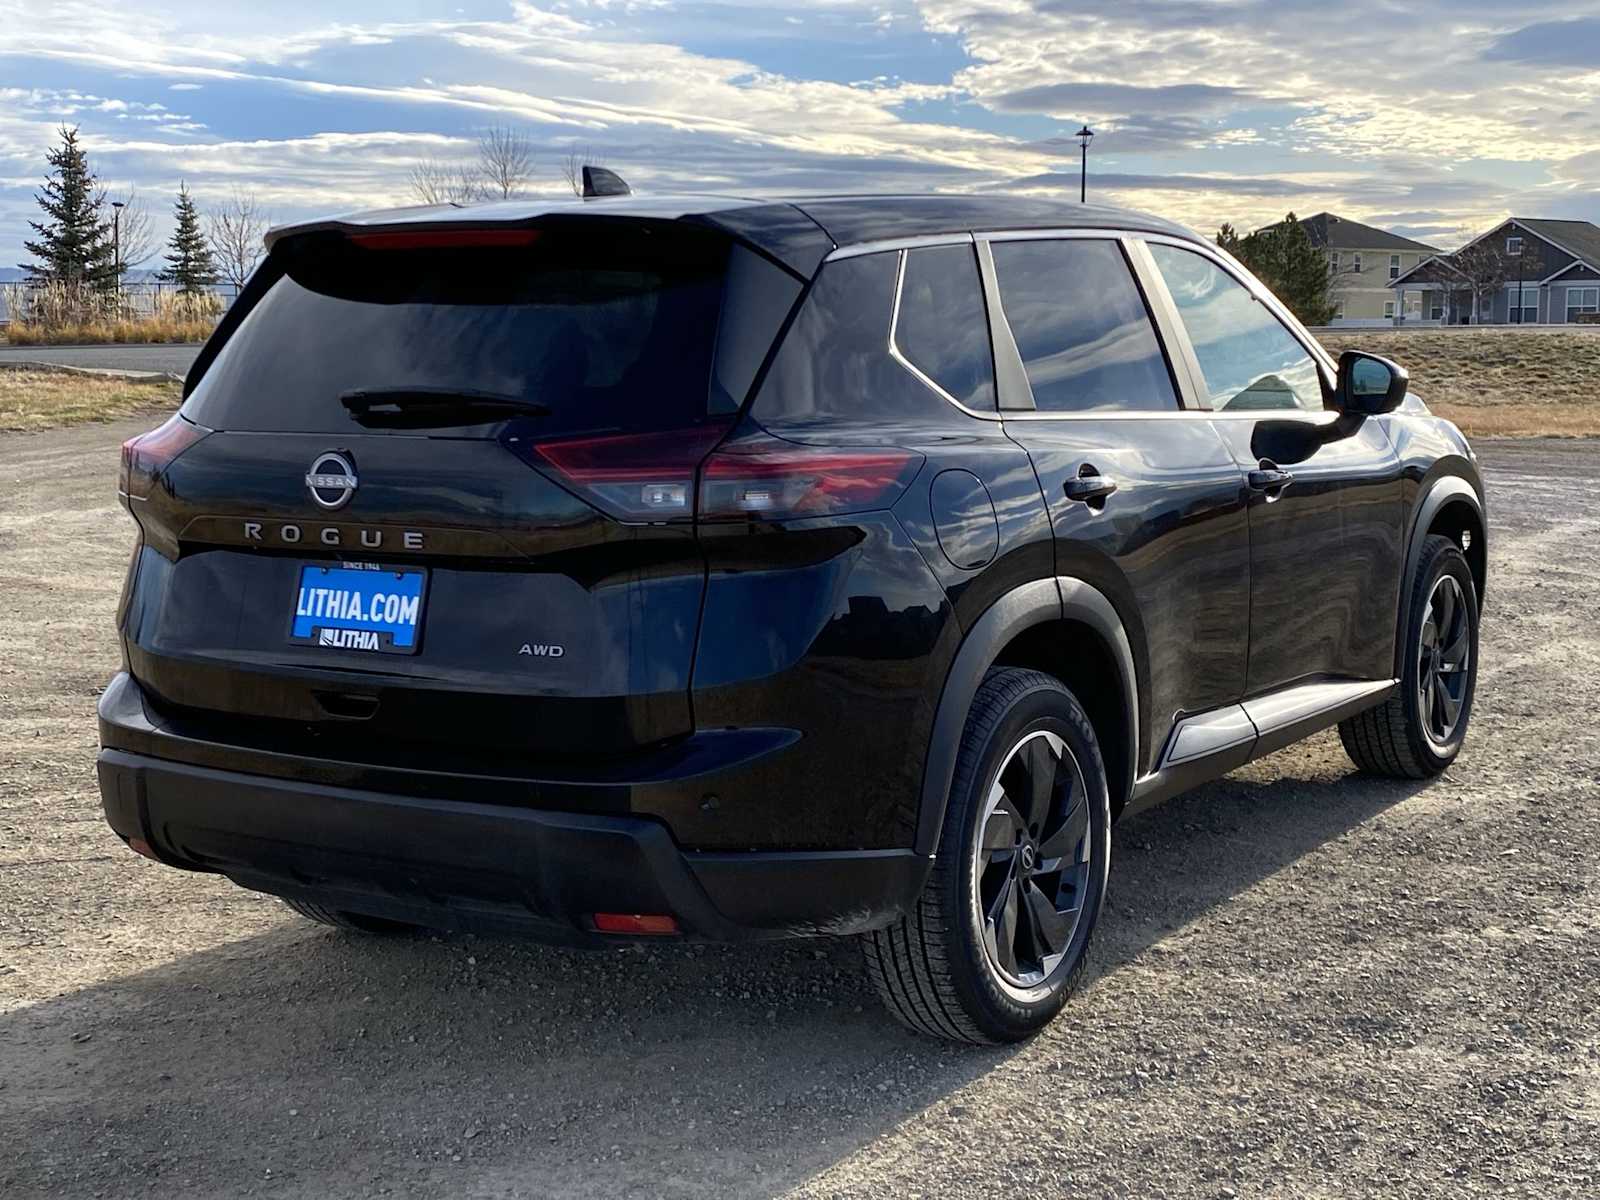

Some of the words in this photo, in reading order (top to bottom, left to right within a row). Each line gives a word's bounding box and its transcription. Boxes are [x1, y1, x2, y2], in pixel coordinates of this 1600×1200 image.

[305, 475, 357, 488] NISSAN
[244, 522, 423, 549] ROGUE
[342, 561, 363, 570] SINCE
[296, 587, 420, 625] LITHIA.COM
[332, 629, 379, 650] LITHIA
[518, 644, 564, 657] AWD
